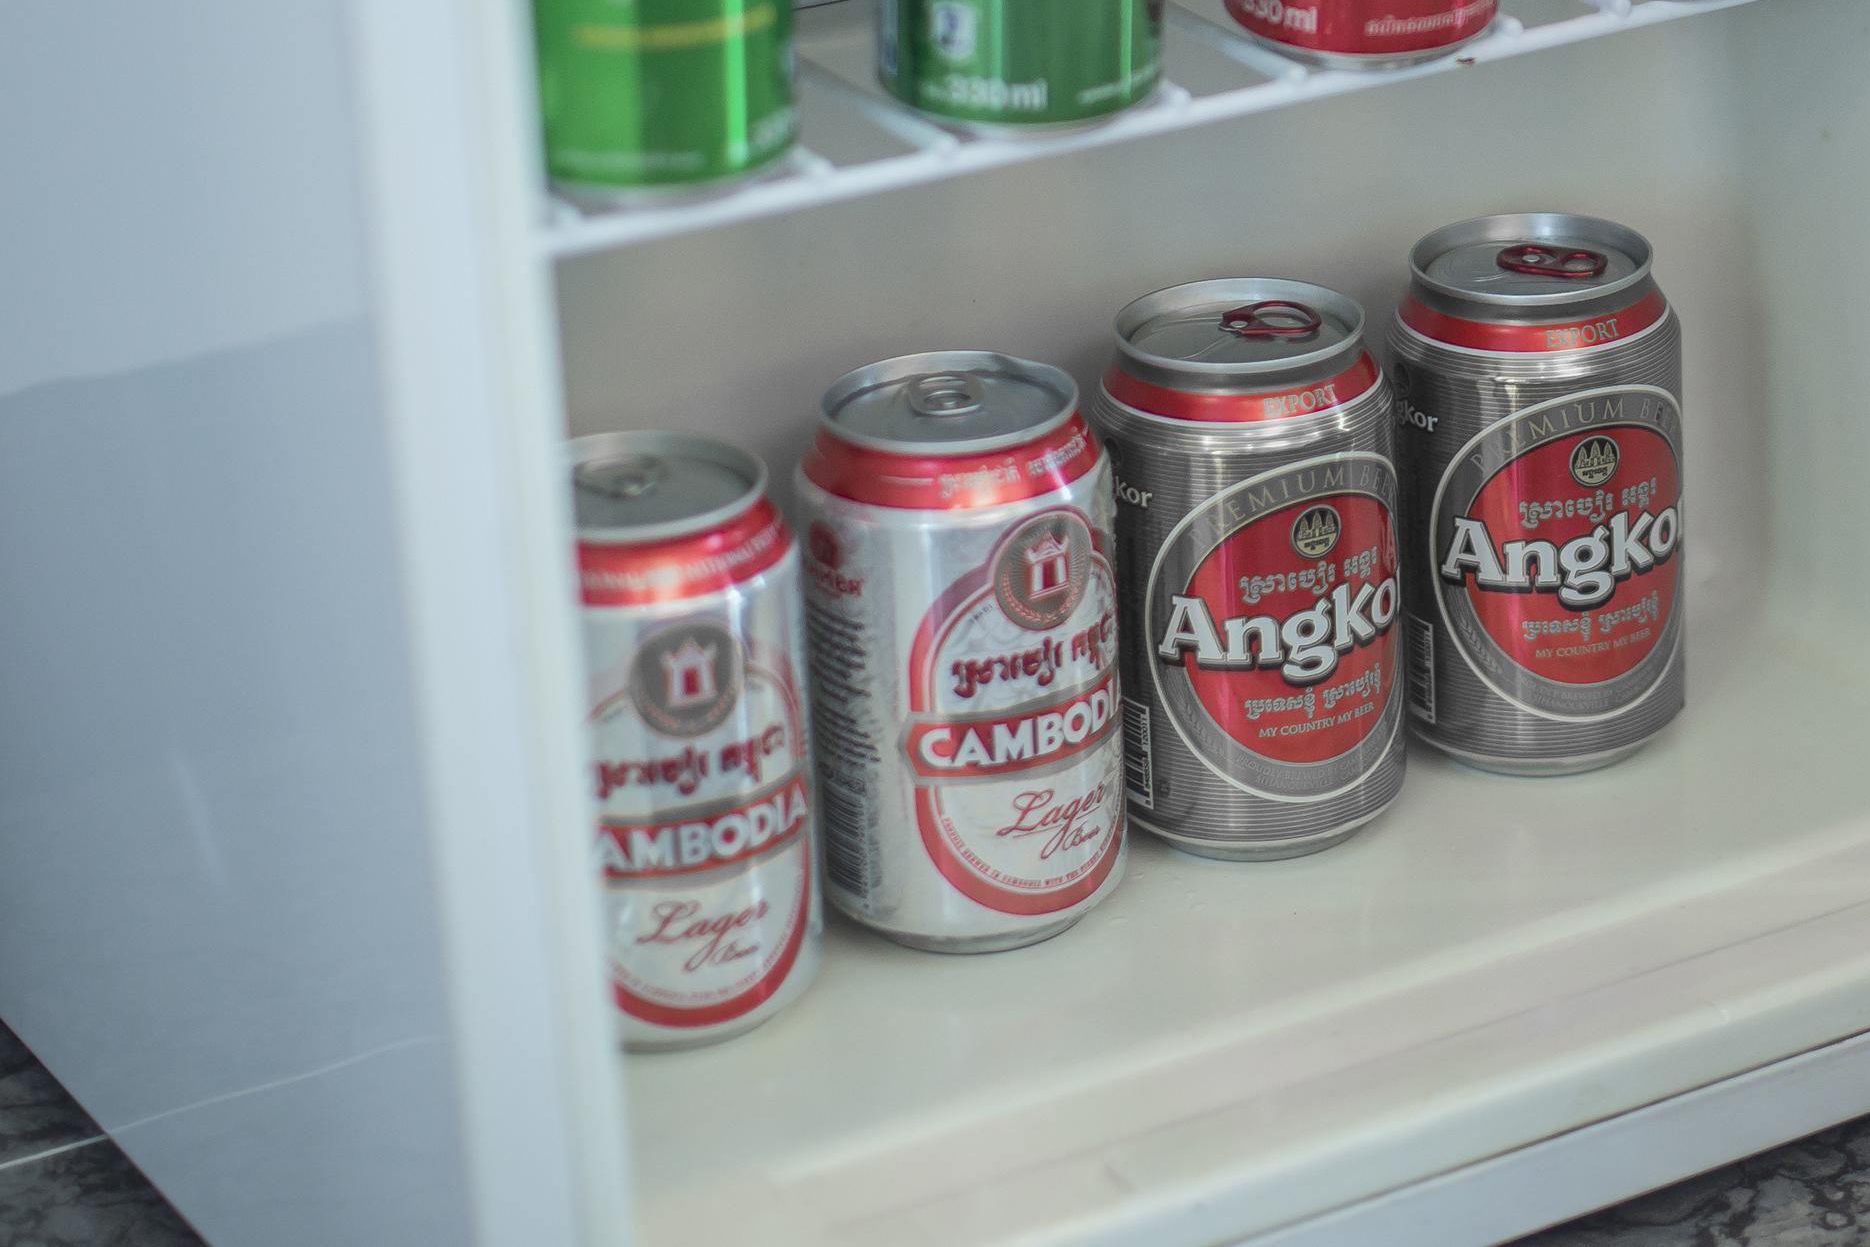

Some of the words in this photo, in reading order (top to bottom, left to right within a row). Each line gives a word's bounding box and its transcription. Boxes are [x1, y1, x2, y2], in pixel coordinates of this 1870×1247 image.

[1545, 318, 1620, 348] EXPORT
[1263, 383, 1338, 419] EXPORT
[1441, 506, 1680, 606] Angko
[1158, 577, 1398, 684] Angko
[1535, 648, 1554, 659] MY
[1556, 641, 1611, 658] COUNTRY
[919, 678, 1119, 767] CAMBODI
[1258, 727, 1278, 738] MY
[1280, 718, 1335, 737] COUNTRY
[1337, 714, 1353, 725] MY
[1354, 702, 1375, 719] BEER
[595, 783, 806, 872] AMBODIA
[996, 779, 1105, 860] Lager
[635, 898, 770, 973] Lager
